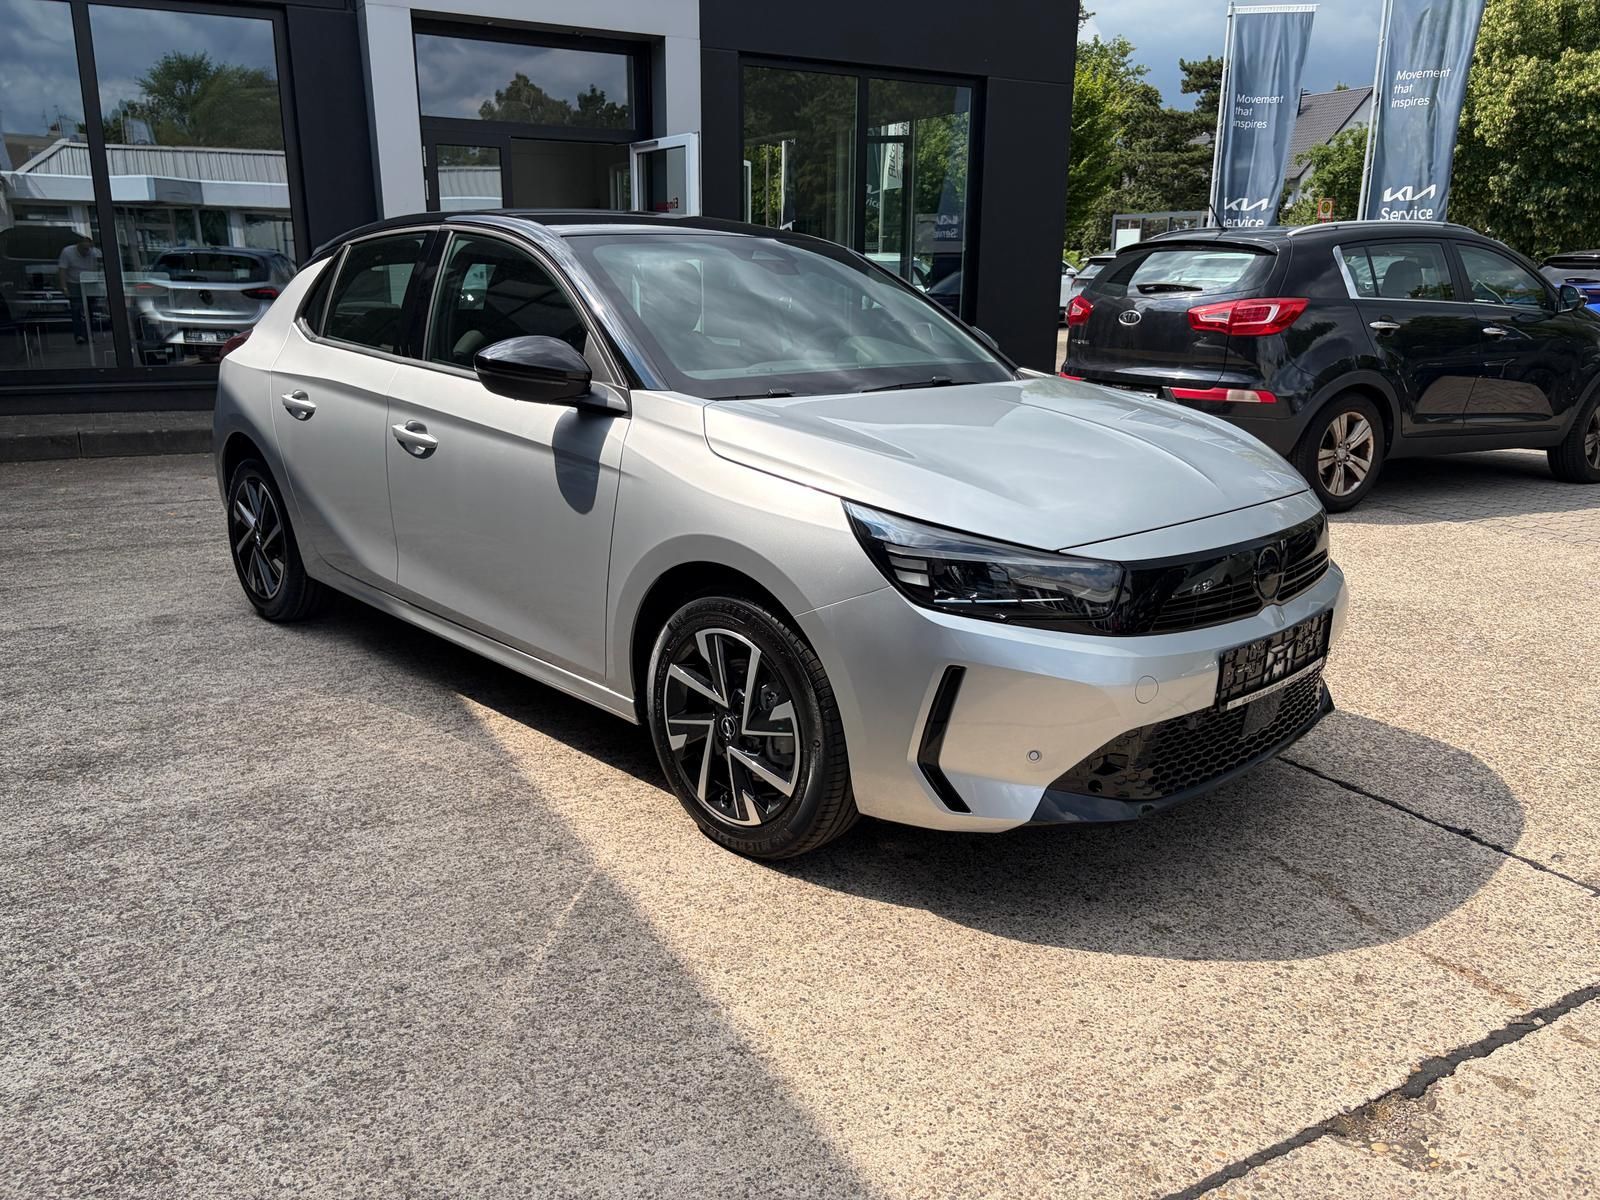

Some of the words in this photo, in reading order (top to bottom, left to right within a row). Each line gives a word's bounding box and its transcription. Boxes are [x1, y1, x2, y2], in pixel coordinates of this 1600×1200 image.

[1396, 68, 1451, 80] Movement
[1394, 84, 1413, 94] that
[1236, 93, 1284, 104] Movement
[1391, 96, 1430, 109] inspires
[1235, 106, 1253, 116] that
[1383, 184, 1436, 202] KIA
[1224, 197, 1269, 211] KIA
[1380, 206, 1433, 221] Service
[1223, 216, 1265, 227] ervice
